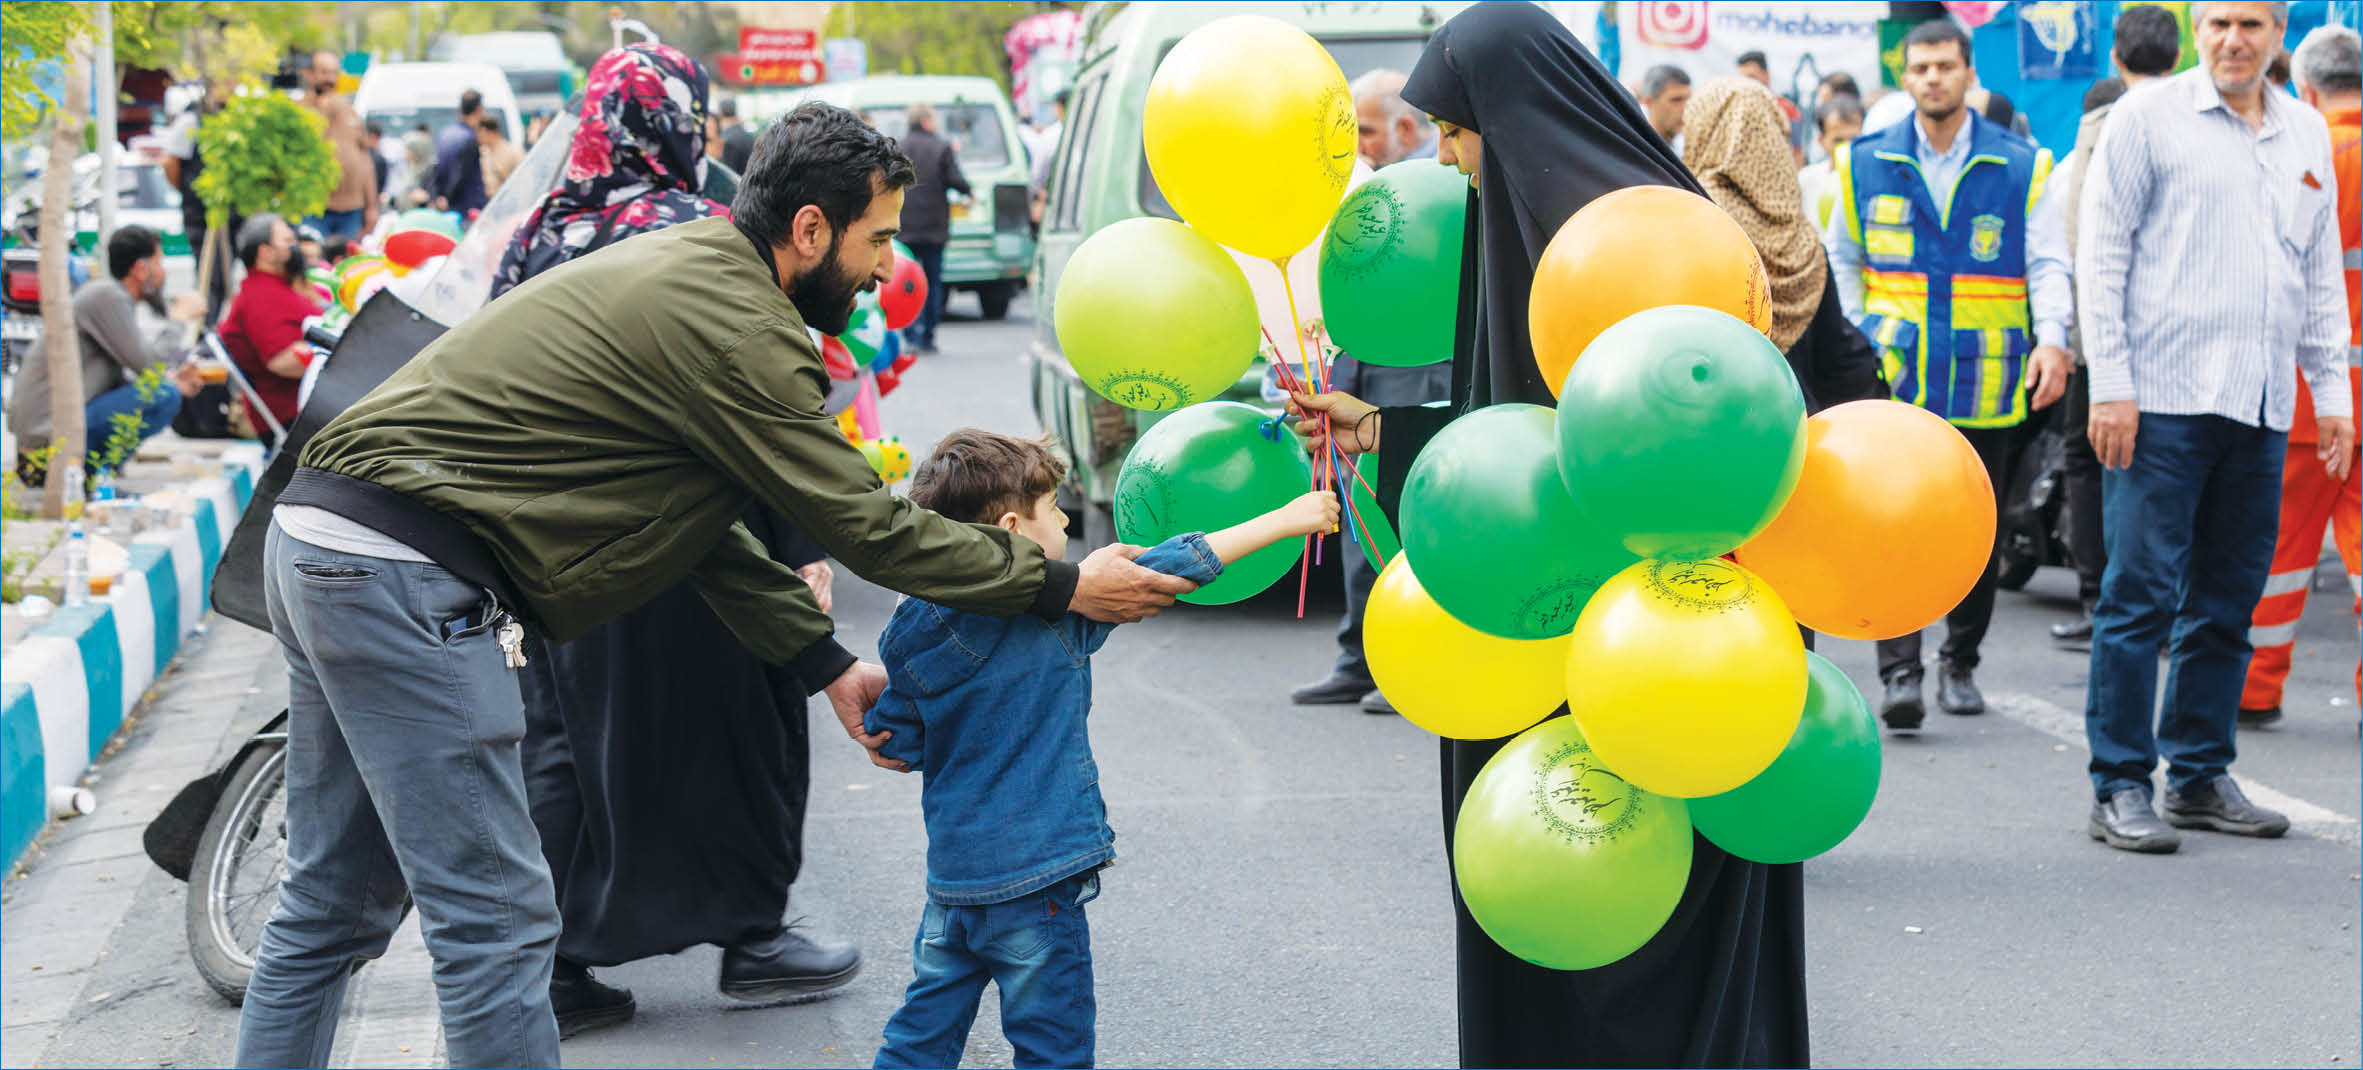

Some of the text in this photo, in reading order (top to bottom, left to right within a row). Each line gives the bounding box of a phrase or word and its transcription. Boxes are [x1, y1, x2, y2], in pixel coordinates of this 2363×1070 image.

[1344, 200, 1380, 217] فطر
[1704, 579, 1736, 597] فطر
[1557, 757, 1625, 786] مبارک
[1550, 782, 1623, 823] عید سعید فطر
